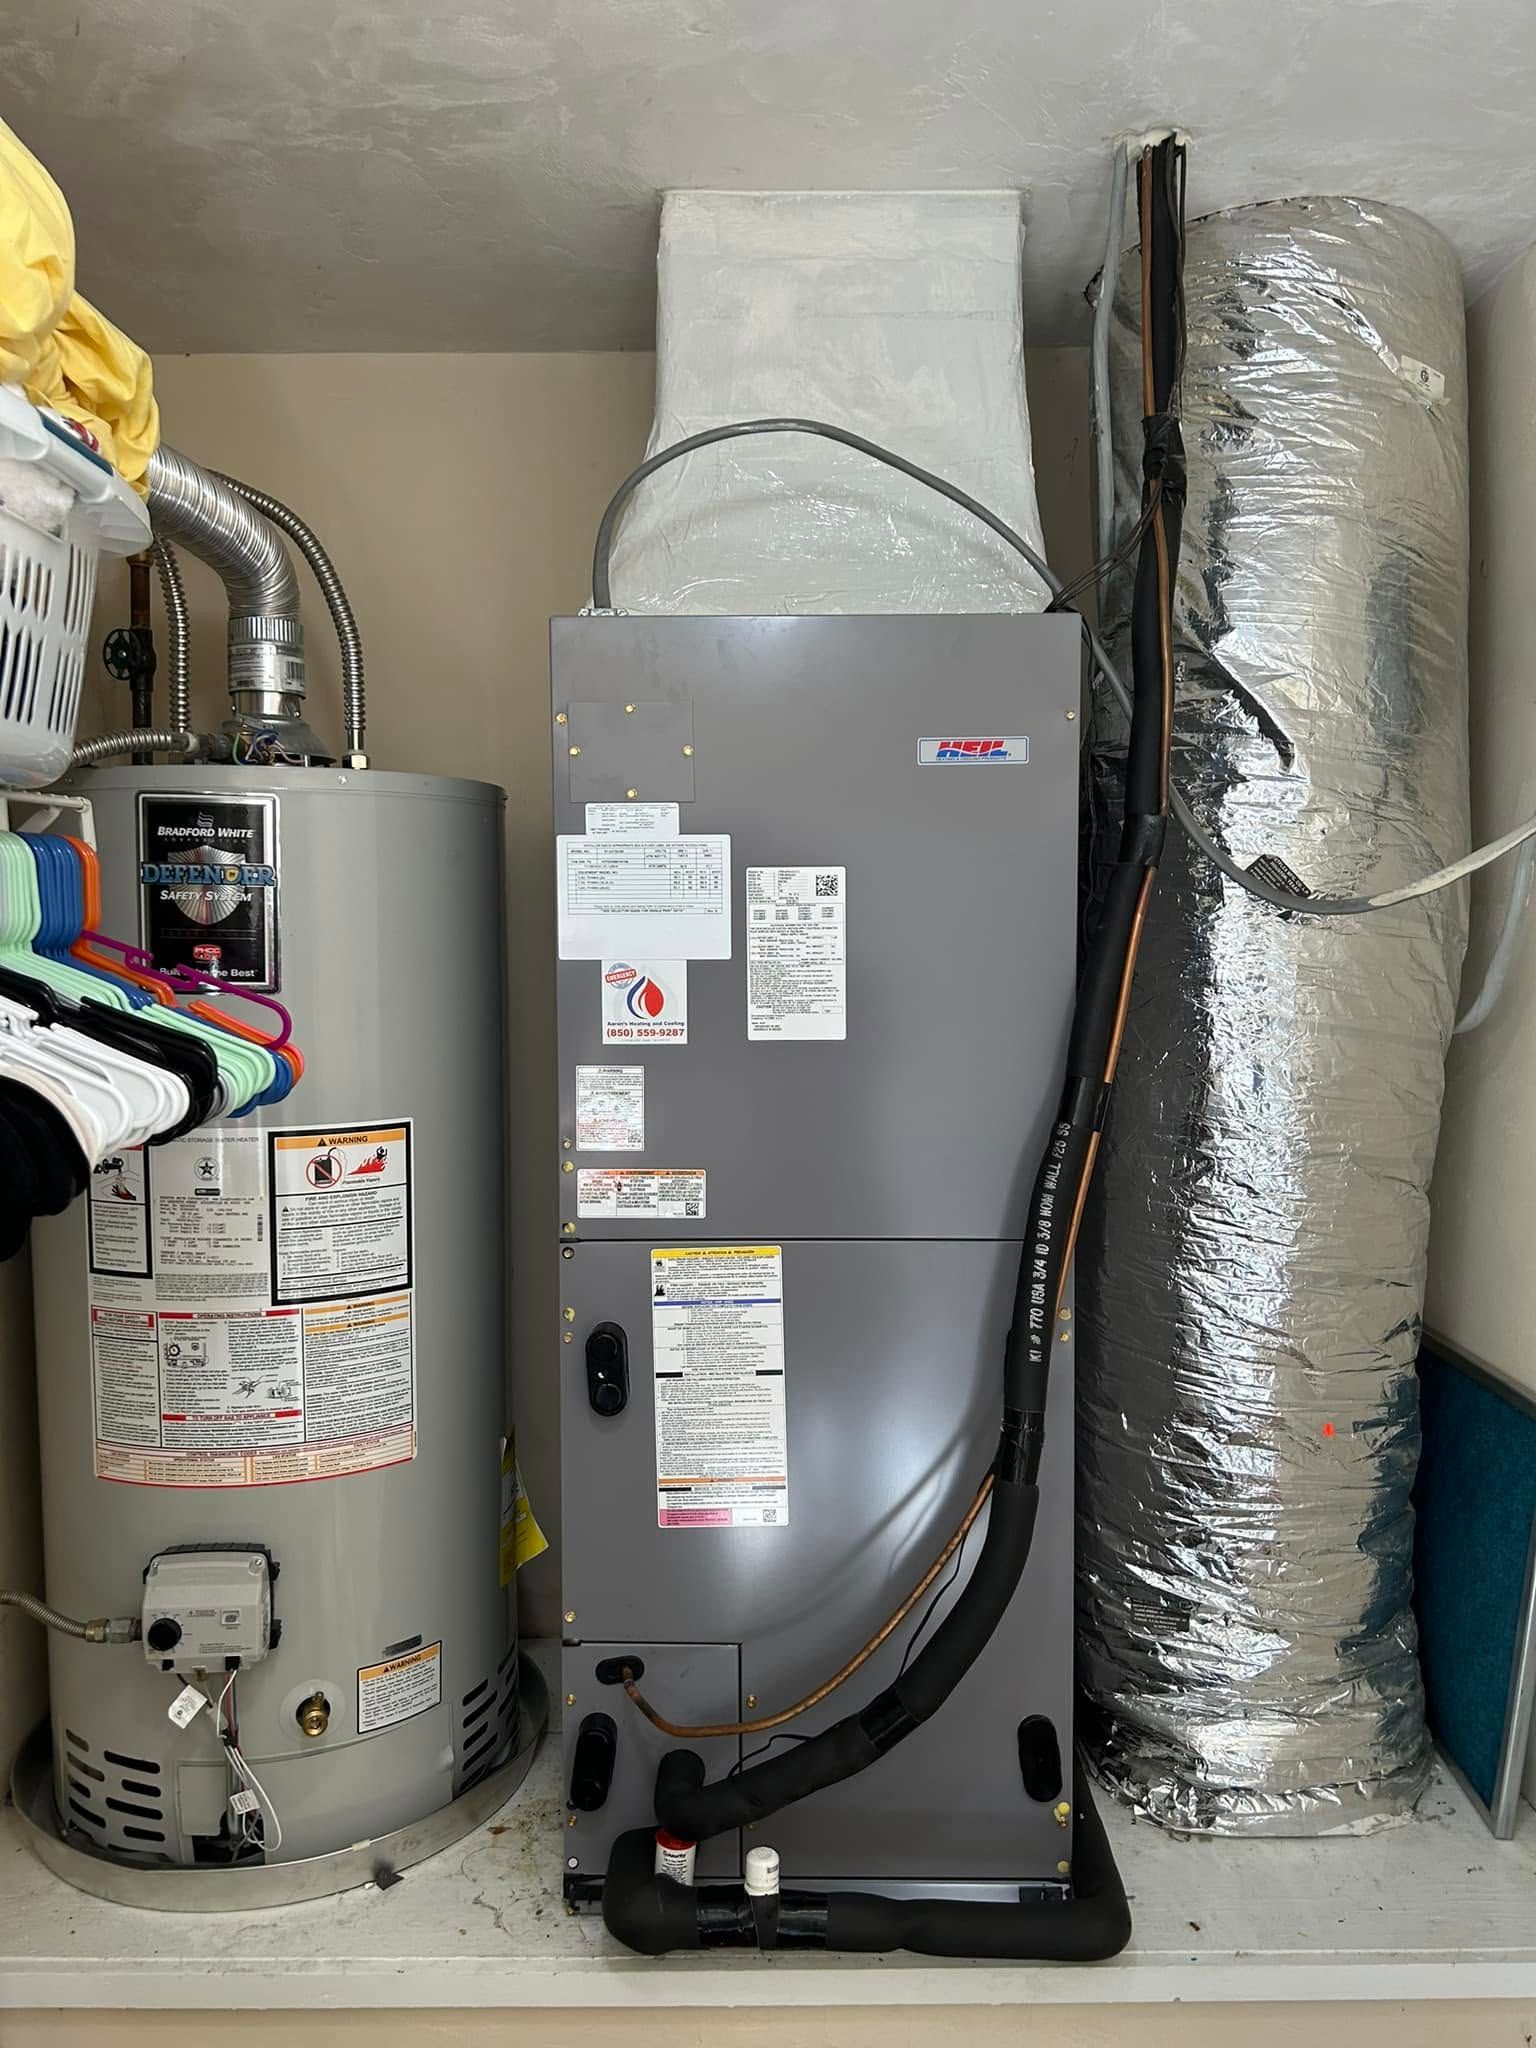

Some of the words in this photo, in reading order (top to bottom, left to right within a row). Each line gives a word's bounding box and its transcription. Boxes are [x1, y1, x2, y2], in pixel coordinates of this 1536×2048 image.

[936, 740, 1008, 757] HEIL
[157, 826, 215, 837] BRADFORD
[217, 828, 254, 838] WHITE
[142, 864, 276, 887] DEFENDER
[160, 890, 204, 900] SAFETY
[204, 891, 252, 902] SYSTEM
[607, 1028, 633, 1037] (850)
[637, 1028, 685, 1037] 559-9287
[328, 1135, 368, 1145] WARNING
[1044, 1161, 1062, 1189] WALL
[1040, 1193, 1056, 1217] NOM
[1035, 1242, 1050, 1256] ID
[1033, 1258, 1048, 1280] 3/4
[1031, 1283, 1046, 1306] USA
[1029, 1308, 1044, 1330] 770
[389, 1654, 422, 1671] WARNING
